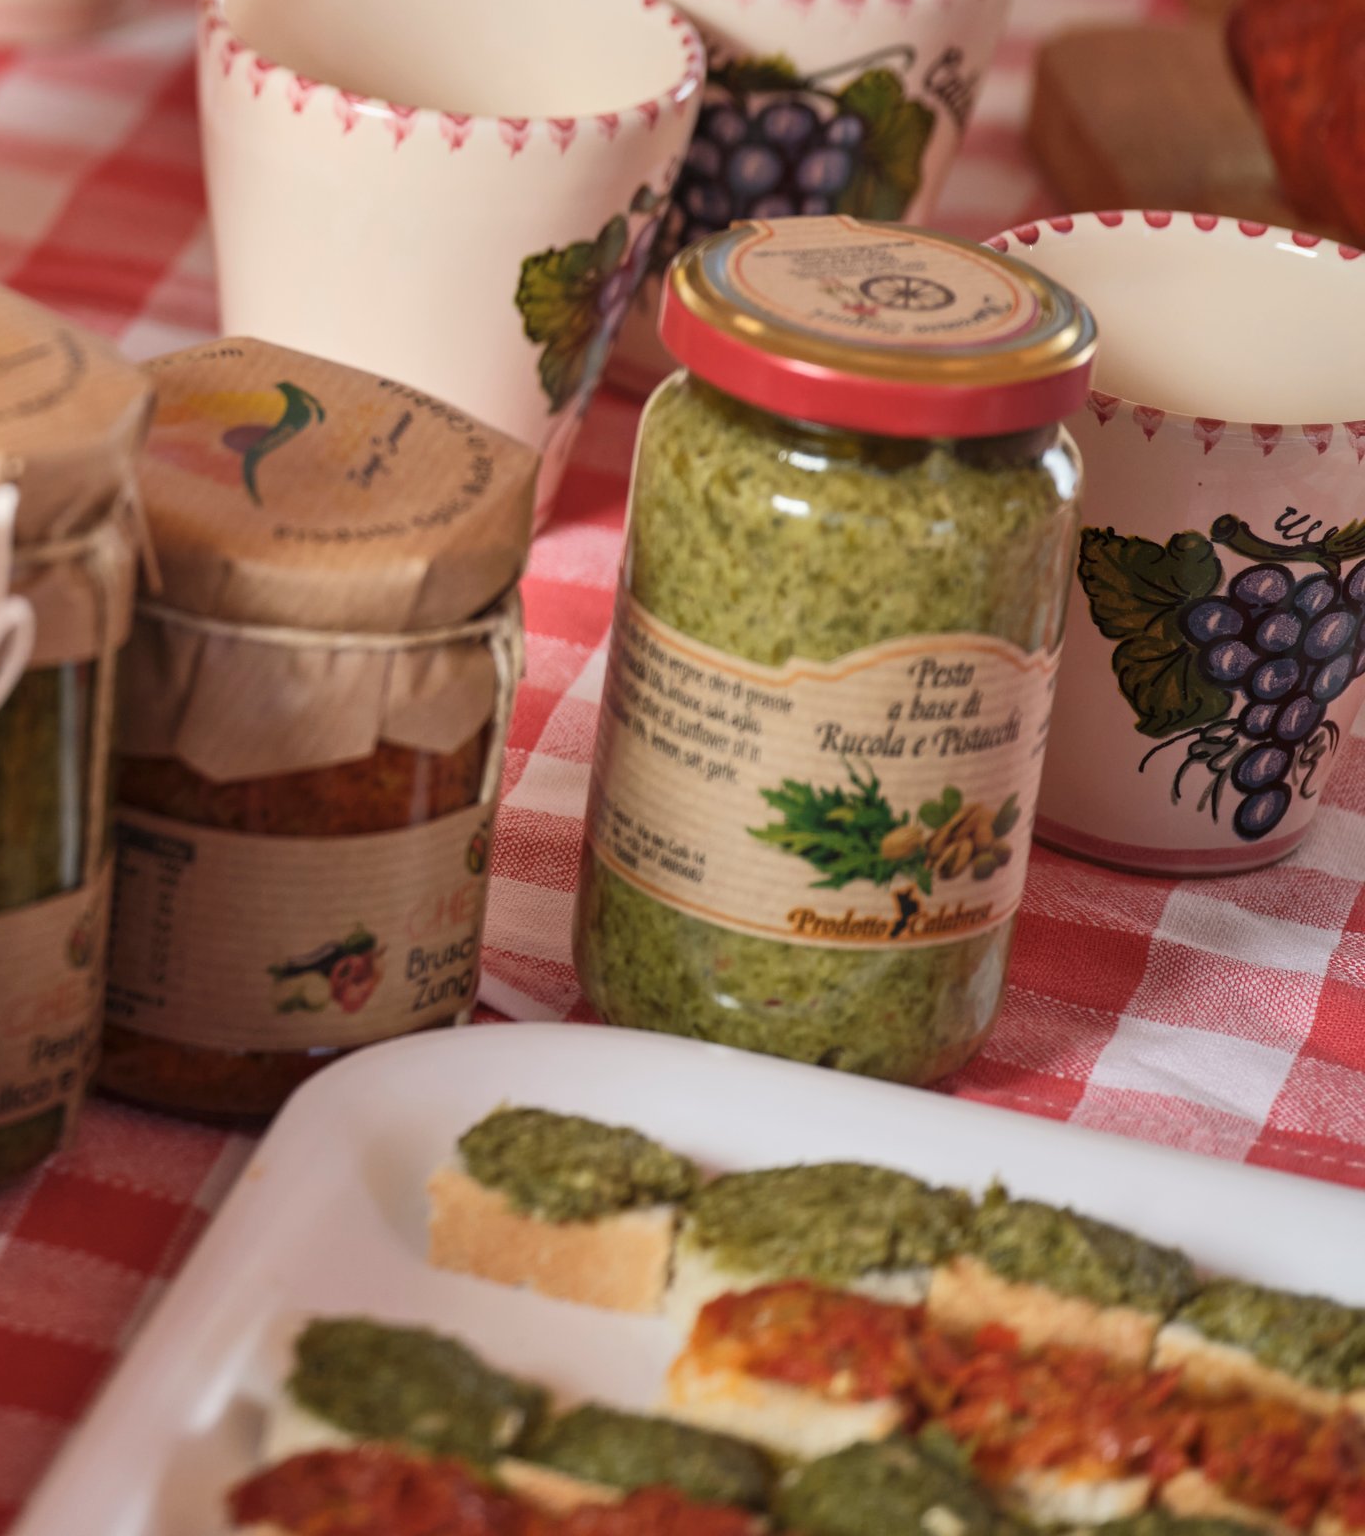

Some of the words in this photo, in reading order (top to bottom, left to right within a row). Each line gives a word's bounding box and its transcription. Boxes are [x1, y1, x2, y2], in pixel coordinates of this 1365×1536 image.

[907, 656, 976, 690] Pesto
[886, 701, 904, 722] a
[908, 693, 959, 722] base
[961, 689, 984, 719] di
[815, 721, 907, 759] Rucola
[911, 736, 928, 758] e
[932, 703, 1023, 758] Pistacchi
[786, 906, 888, 937] Prodotto
